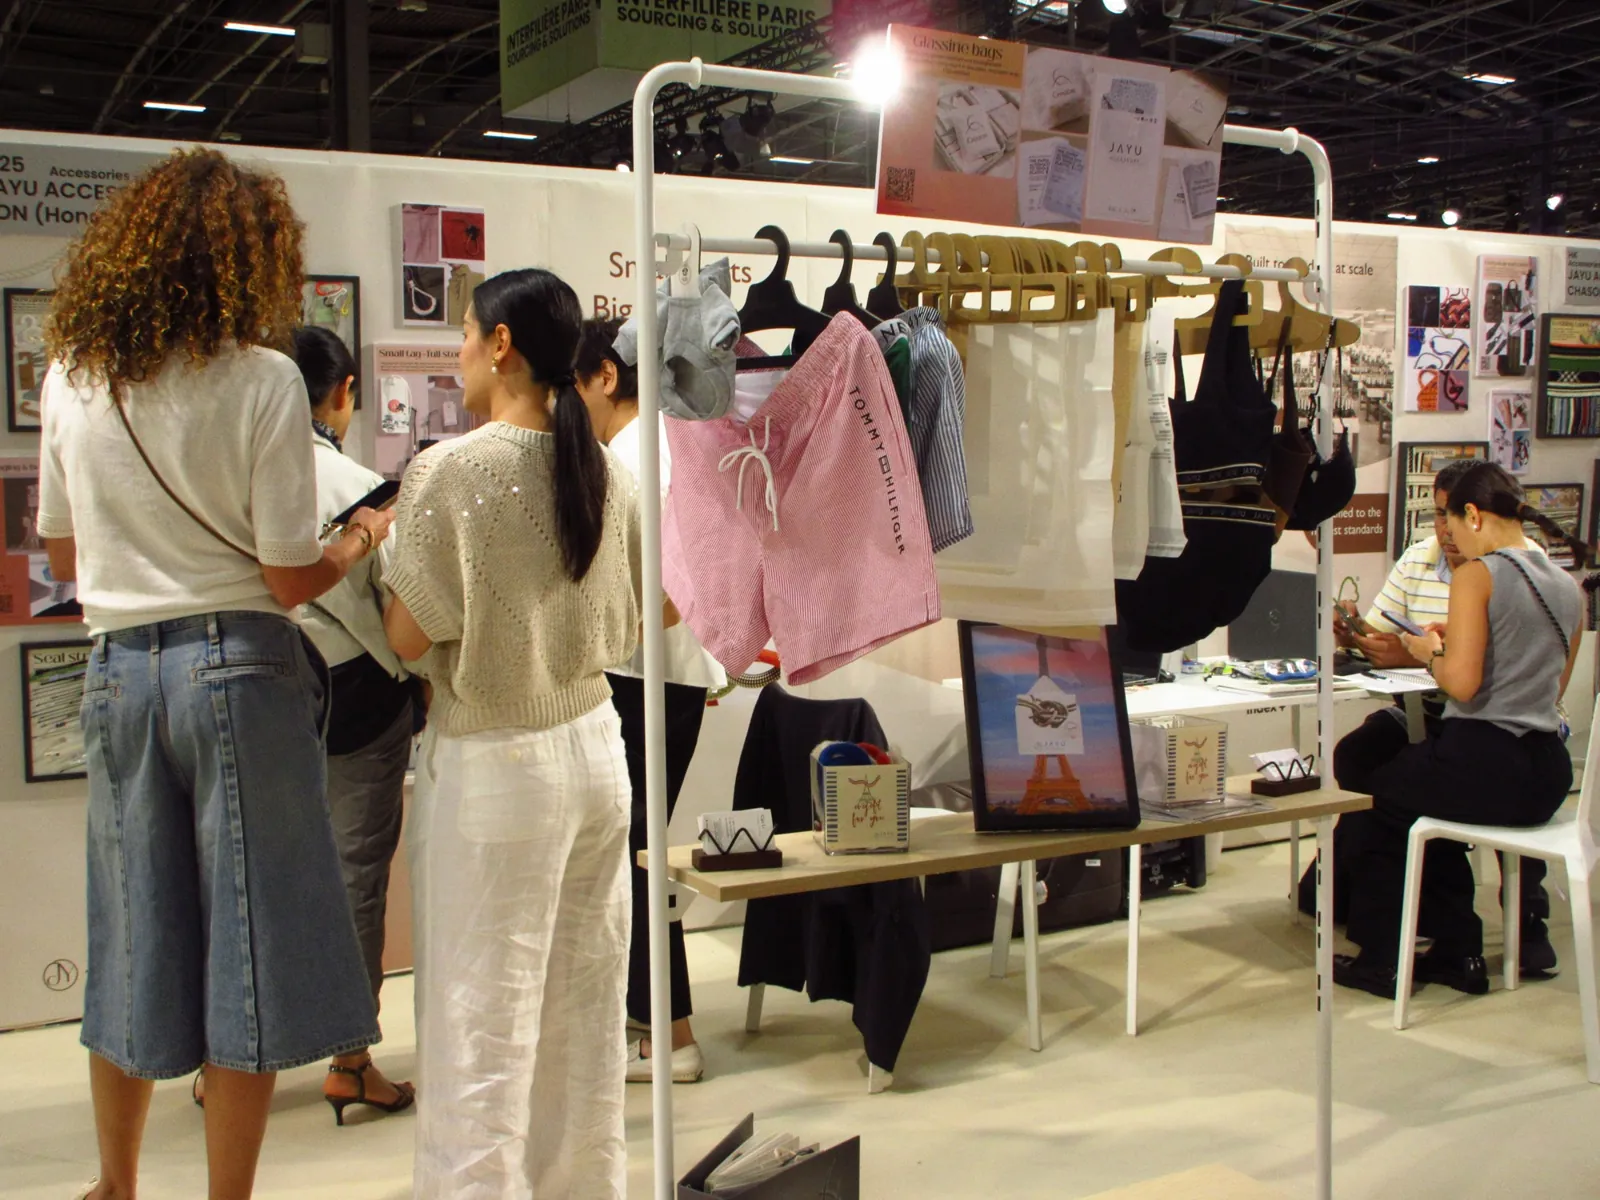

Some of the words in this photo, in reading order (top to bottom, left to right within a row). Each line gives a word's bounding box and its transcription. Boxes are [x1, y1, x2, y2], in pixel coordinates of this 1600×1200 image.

[617, 6, 706, 30] SOURCING
[711, 18, 723, 33] &
[758, 3, 816, 26] PARIS
[913, 34, 969, 54] Glassine
[972, 42, 1004, 61] bags
[1109, 142, 1142, 156] JAYU
[0, 155, 25, 173] 25
[49, 166, 131, 181] Accessories
[1335, 263, 1346, 275] at
[1348, 262, 1374, 276] scale
[1567, 269, 1592, 281] JAYU
[379, 349, 404, 357] Small
[406, 350, 422, 360] tag
[427, 350, 441, 358] full
[849, 387, 886, 452] TOMMY
[884, 475, 906, 556] HILFIGER
[1356, 509, 1366, 517] to
[1368, 507, 1382, 517] the
[1344, 524, 1383, 535] standards
[33, 653, 66, 664] Seal
